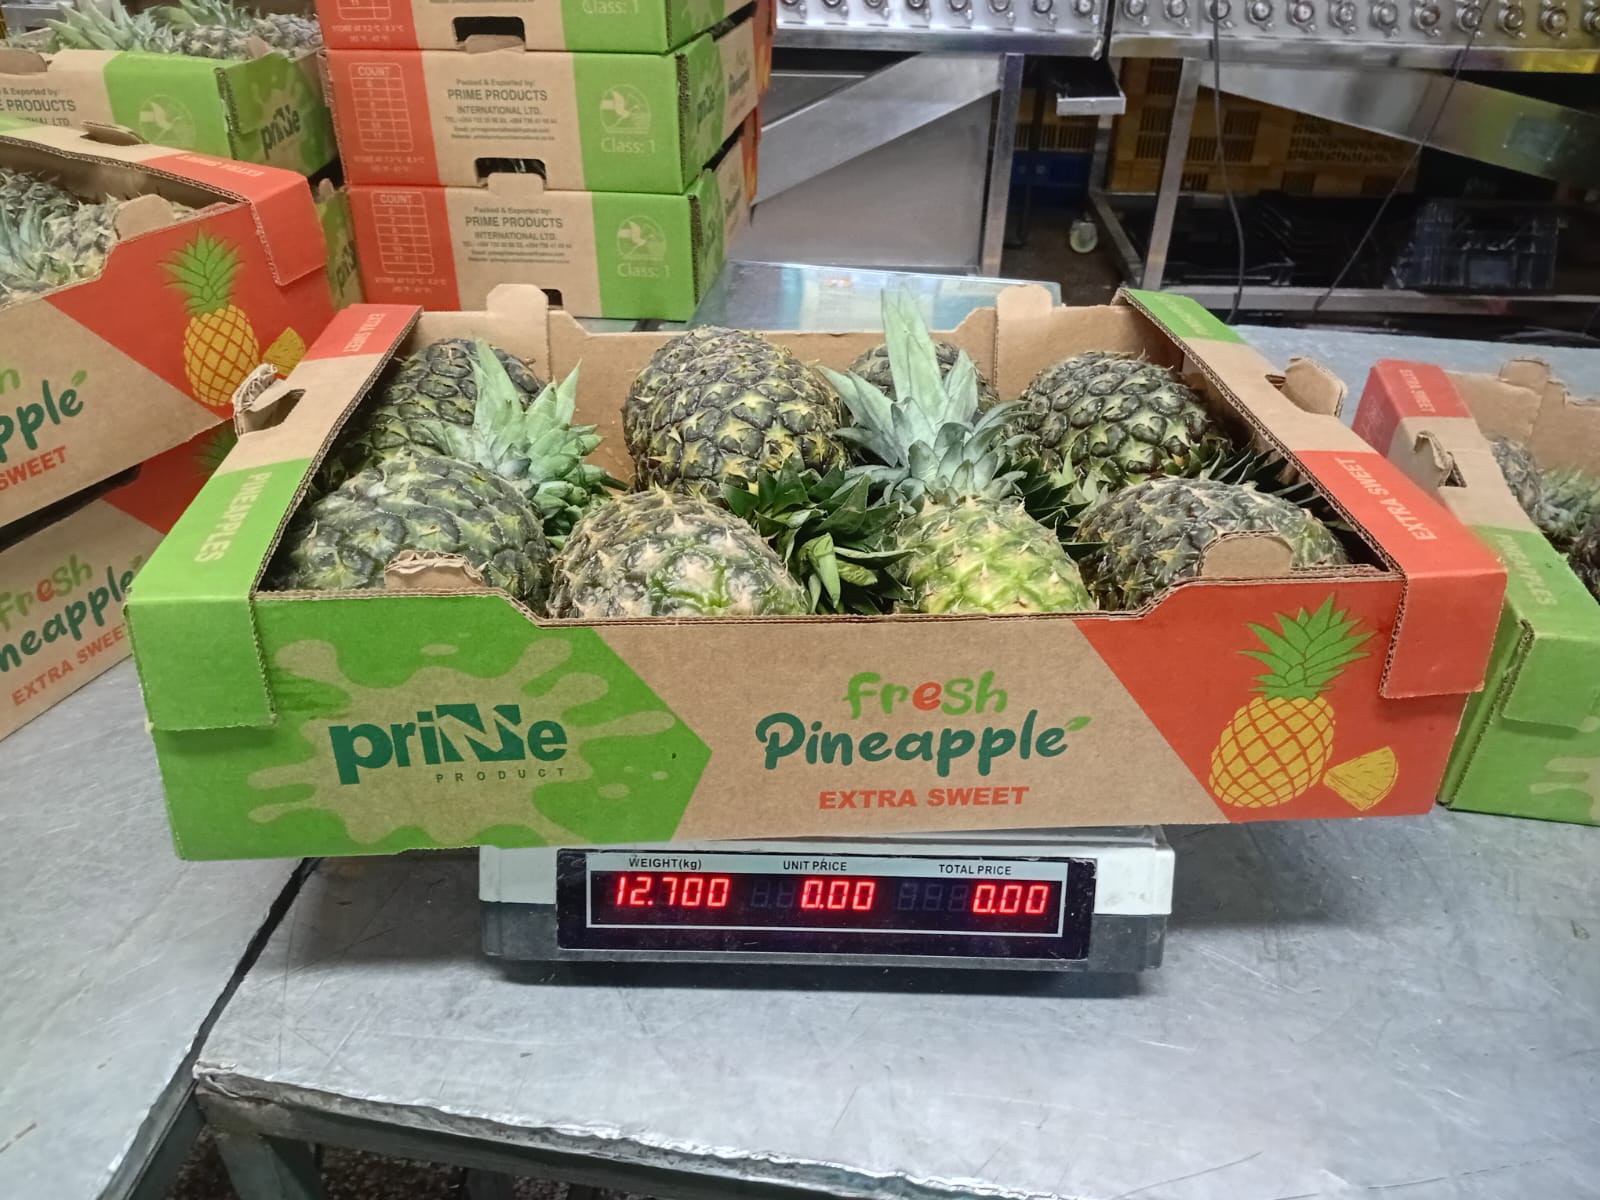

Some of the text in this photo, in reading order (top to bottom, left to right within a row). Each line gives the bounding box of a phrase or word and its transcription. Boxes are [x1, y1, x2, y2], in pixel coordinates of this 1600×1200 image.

[358, 66, 390, 76] COUNT
[11, 87, 46, 96] Exported
[447, 89, 549, 101] PRIME PRODUCTS
[6, 99, 77, 112] PRODUCTS
[457, 105, 522, 115] INTERNATIONAL
[601, 138, 648, 153] Class:
[380, 194, 413, 204] COUNT
[465, 216, 564, 229] PRIME PRODUCTS
[474, 231, 538, 241] INTERNATIONAL
[616, 263, 661, 278] Class:
[0, 445, 67, 492] SWEET
[1334, 457, 1438, 541] EXTRA SWEET
[0, 565, 134, 673] neapple
[11, 622, 127, 706] EXTRA SWEE
[755, 709, 1070, 778] Pineapple
[436, 767, 565, 784] PRODUCT
[818, 786, 1030, 810] EXTRA SWEET
[628, 857, 702, 871] WEIGHT(kg)
[783, 860, 847, 872] UNIT PRICE
[938, 863, 1012, 877] TOTAL PRICE
[615, 876, 731, 907] 12.700
[800, 879, 876, 911] 0.00
[972, 884, 1049, 914] 0.00
